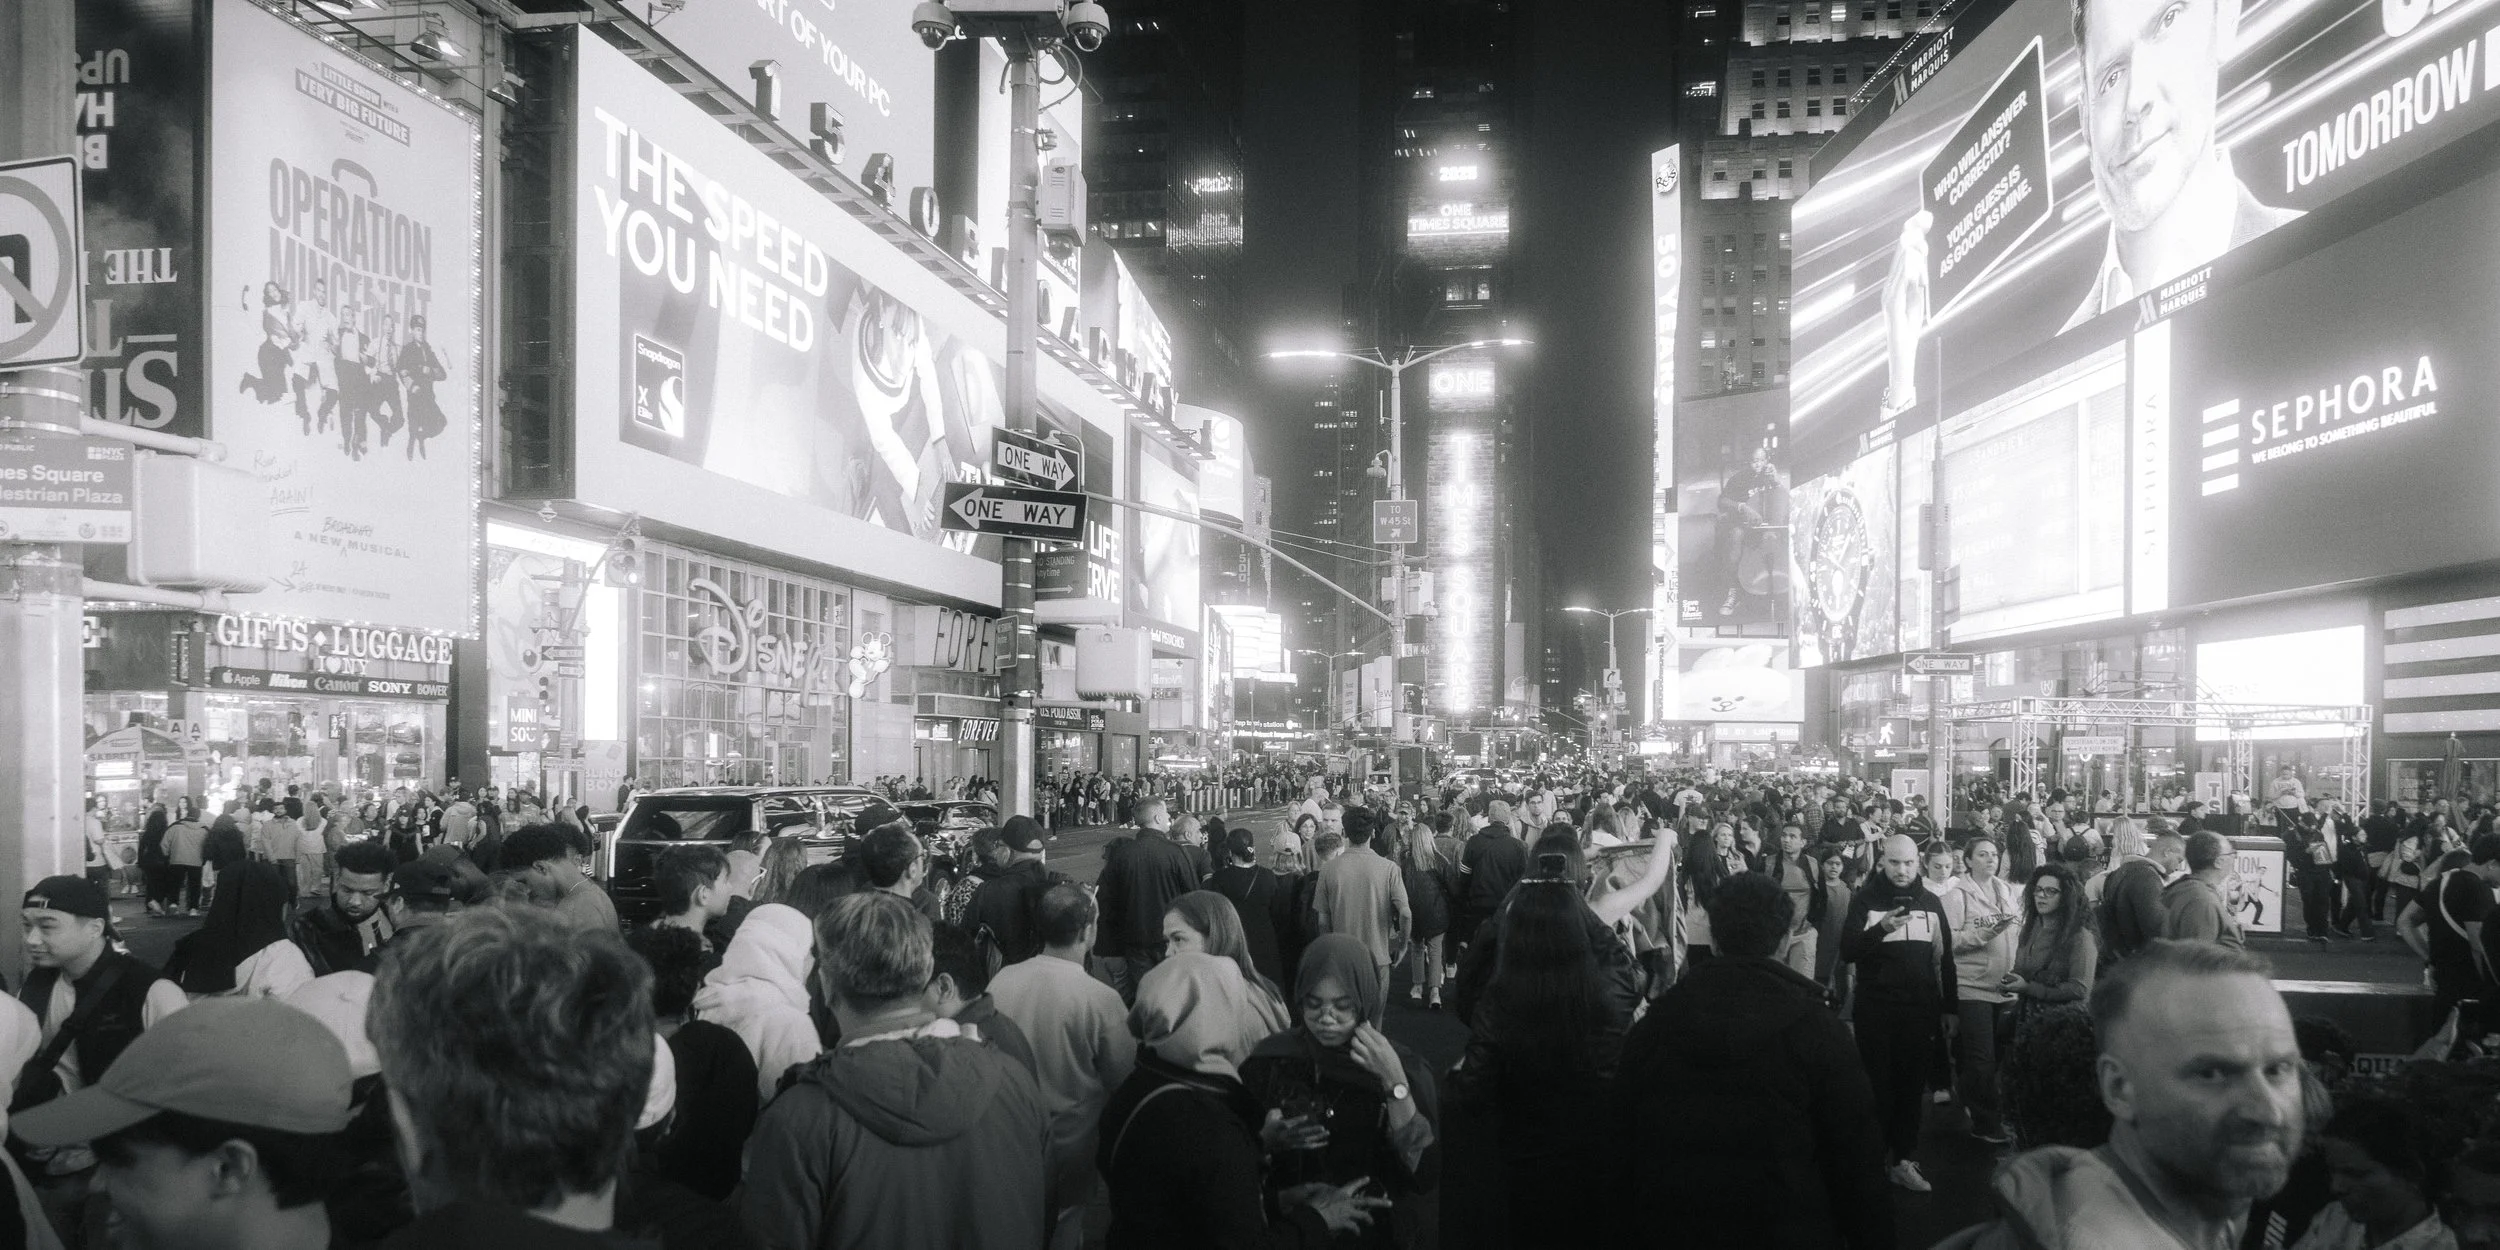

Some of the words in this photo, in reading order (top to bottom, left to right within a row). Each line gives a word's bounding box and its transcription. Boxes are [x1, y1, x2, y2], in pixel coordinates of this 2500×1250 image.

[75, 48, 130, 85] UP
[791, 9, 817, 49] OF
[820, 32, 866, 98] YOUR
[868, 77, 890, 117] PC
[1910, 26, 1955, 76] MARRIOTT
[1910, 49, 1949, 92] MARQUIS
[299, 73, 335, 104] VERY
[336, 93, 360, 119] BIG
[360, 104, 409, 145] FUTURE
[2283, 38, 2477, 193] TOMORROW
[749, 59, 940, 238] 1540
[1933, 167, 1959, 201] WHO
[1957, 140, 1981, 178] WILL
[1979, 90, 2028, 152] ANSWER
[1950, 130, 2011, 205] CORRECTLY?
[595, 106, 694, 225] THE
[704, 179, 828, 298] SPEED
[1440, 203, 1472, 216] ONE
[1946, 211, 1974, 248] YOUR
[1974, 179, 2008, 223] GUESS
[2006, 164, 2021, 188] IS
[269, 158, 431, 286] OPERATION
[1411, 218, 1451, 231] TIMES
[1452, 215, 1508, 230] SQUARE
[1939, 254, 1954, 279] AS
[1953, 226, 1984, 263] GOOD
[1983, 210, 2000, 236] AS
[1999, 178, 2033, 219] MINE.
[104, 247, 178, 285] THE
[594, 185, 695, 294] YOU
[708, 250, 813, 352] NEED
[1657, 233, 1678, 278] 50
[2159, 266, 2213, 301] MARRIOTT
[2159, 285, 2207, 315] MARQUIS
[637, 342, 682, 371] Snapdragon
[638, 385, 648, 407] X
[1434, 371, 1492, 394] ONE
[2251, 354, 2439, 446] SEPHORA
[2251, 450, 2267, 464] WE
[2266, 440, 2305, 461] BELONG
[2304, 435, 2319, 450] TO
[2318, 417, 2380, 447] SOMETHING
[2380, 401, 2439, 428] BEAUTIFUL
[32, 464, 105, 485] Square
[1004, 446, 1031, 471] ONE
[1041, 457, 1067, 481] WAY
[73, 487, 124, 505] Plaza
[964, 498, 1004, 519] ONE
[1023, 503, 1067, 526] WAY
[1390, 505, 1400, 515] TO
[1450, 435, 1474, 558] TIMES
[1380, 517, 1388, 525] W
[1388, 516, 1400, 526] 45
[294, 530, 304, 541] A
[309, 532, 343, 548] NEW
[347, 540, 411, 560] MUSICAL
[1046, 555, 1075, 567] STANDING
[1090, 520, 1120, 566] LIFE
[217, 614, 309, 652] GIFTS
[330, 625, 453, 666] LUGGAGE
[933, 605, 998, 674] FORE
[1449, 566, 1472, 712] SQUARE
[317, 655, 326, 673] I
[341, 657, 369, 675] NY
[1914, 658, 1935, 670] ONE
[1944, 658, 1966, 670] WAY
[233, 673, 261, 686] Apple
[268, 673, 308, 689] Nikon
[314, 677, 360, 693] Canon
[367, 681, 412, 694] SONY
[416, 684, 448, 696] BOWER
[171, 722, 181, 733] A
[510, 707, 537, 723] MINI
[959, 719, 1001, 742] FOREVER
[1050, 707, 1066, 719] POLO
